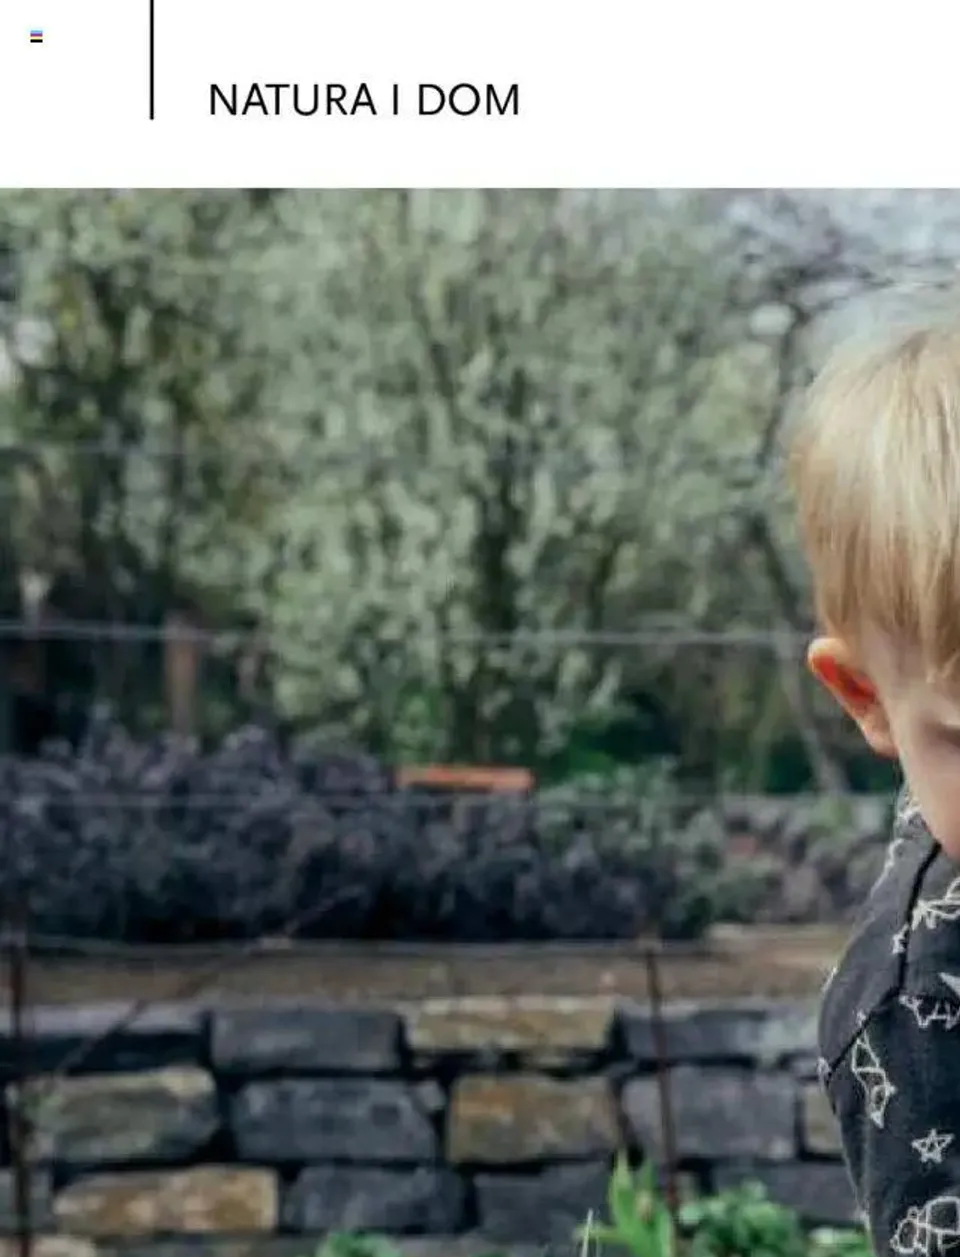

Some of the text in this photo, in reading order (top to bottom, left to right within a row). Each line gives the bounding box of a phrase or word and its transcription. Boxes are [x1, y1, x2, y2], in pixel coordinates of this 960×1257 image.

[209, 82, 520, 117] NATURA I DOM
